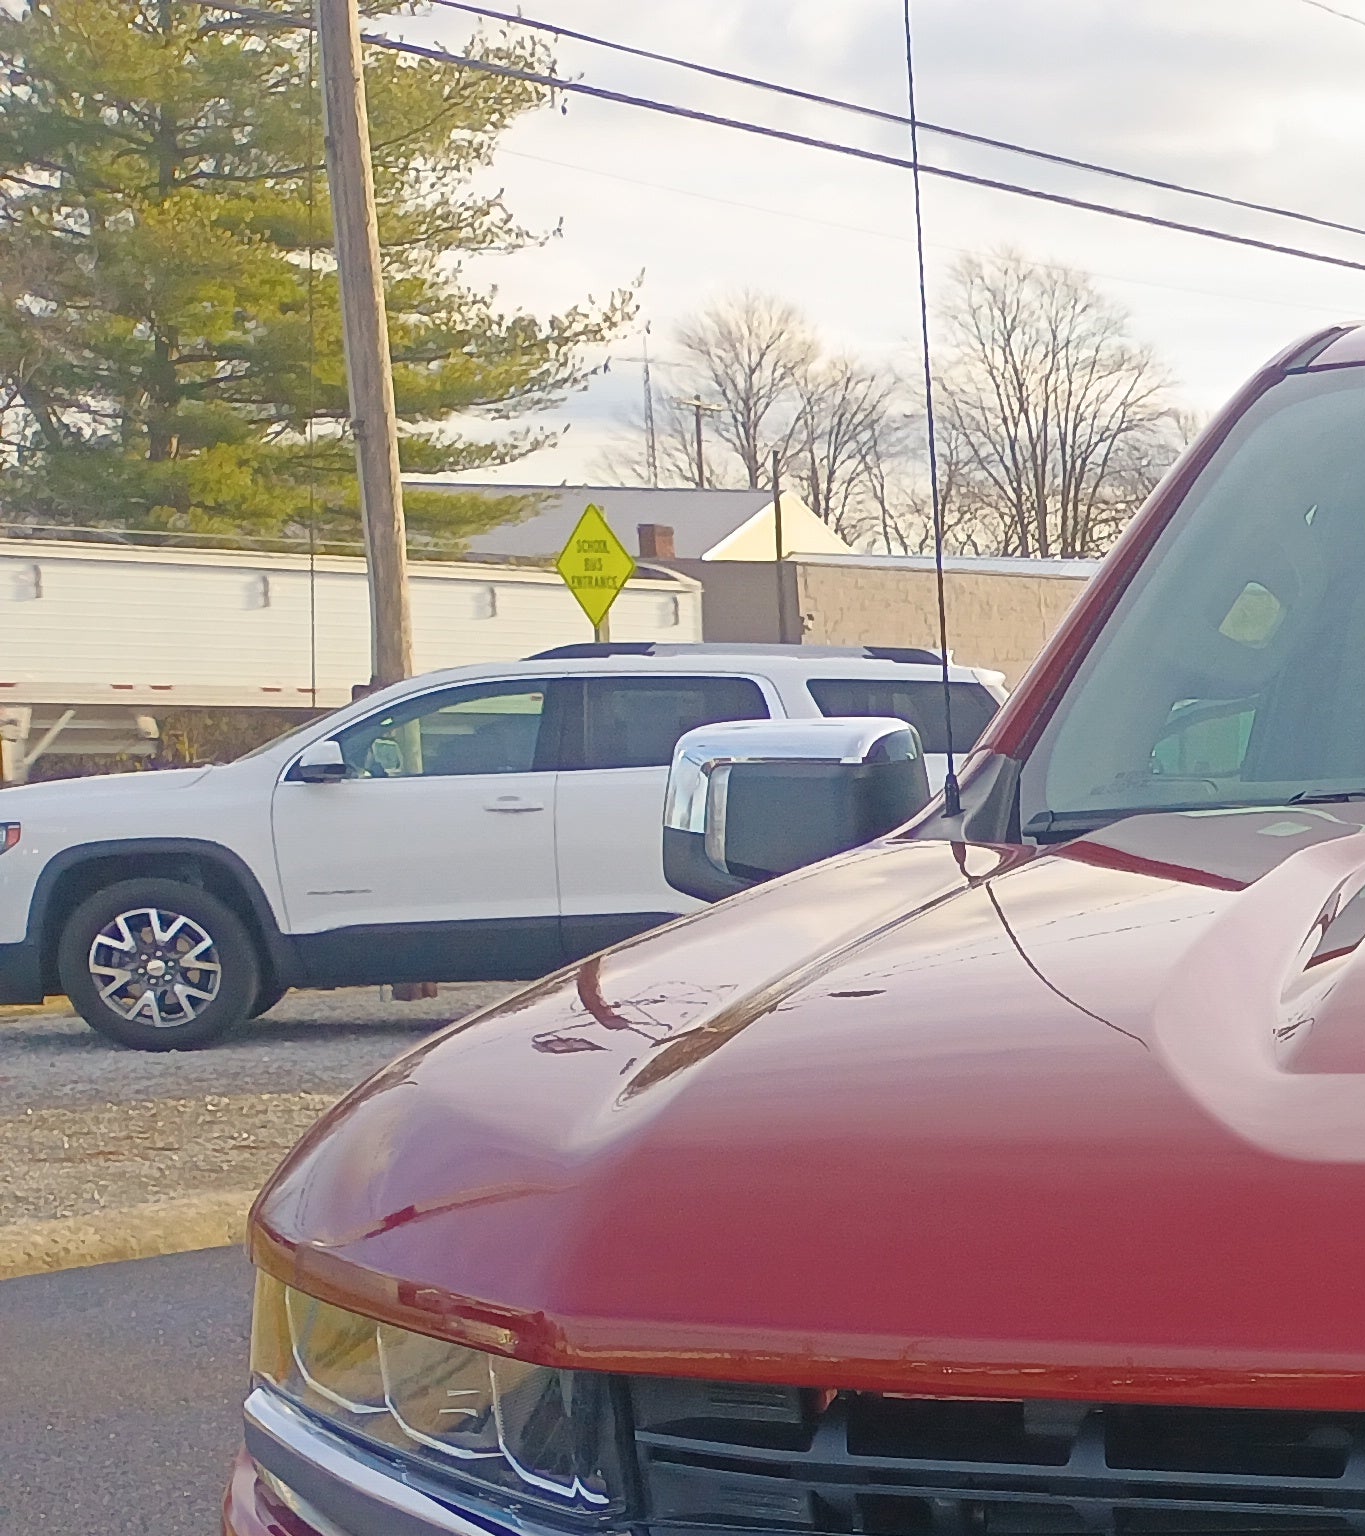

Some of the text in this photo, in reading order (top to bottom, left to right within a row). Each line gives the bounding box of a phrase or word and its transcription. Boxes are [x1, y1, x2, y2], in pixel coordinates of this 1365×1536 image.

[576, 539, 610, 553] SCHOOL
[584, 558, 602, 571] BUS
[571, 575, 618, 589] ENTRANCE
